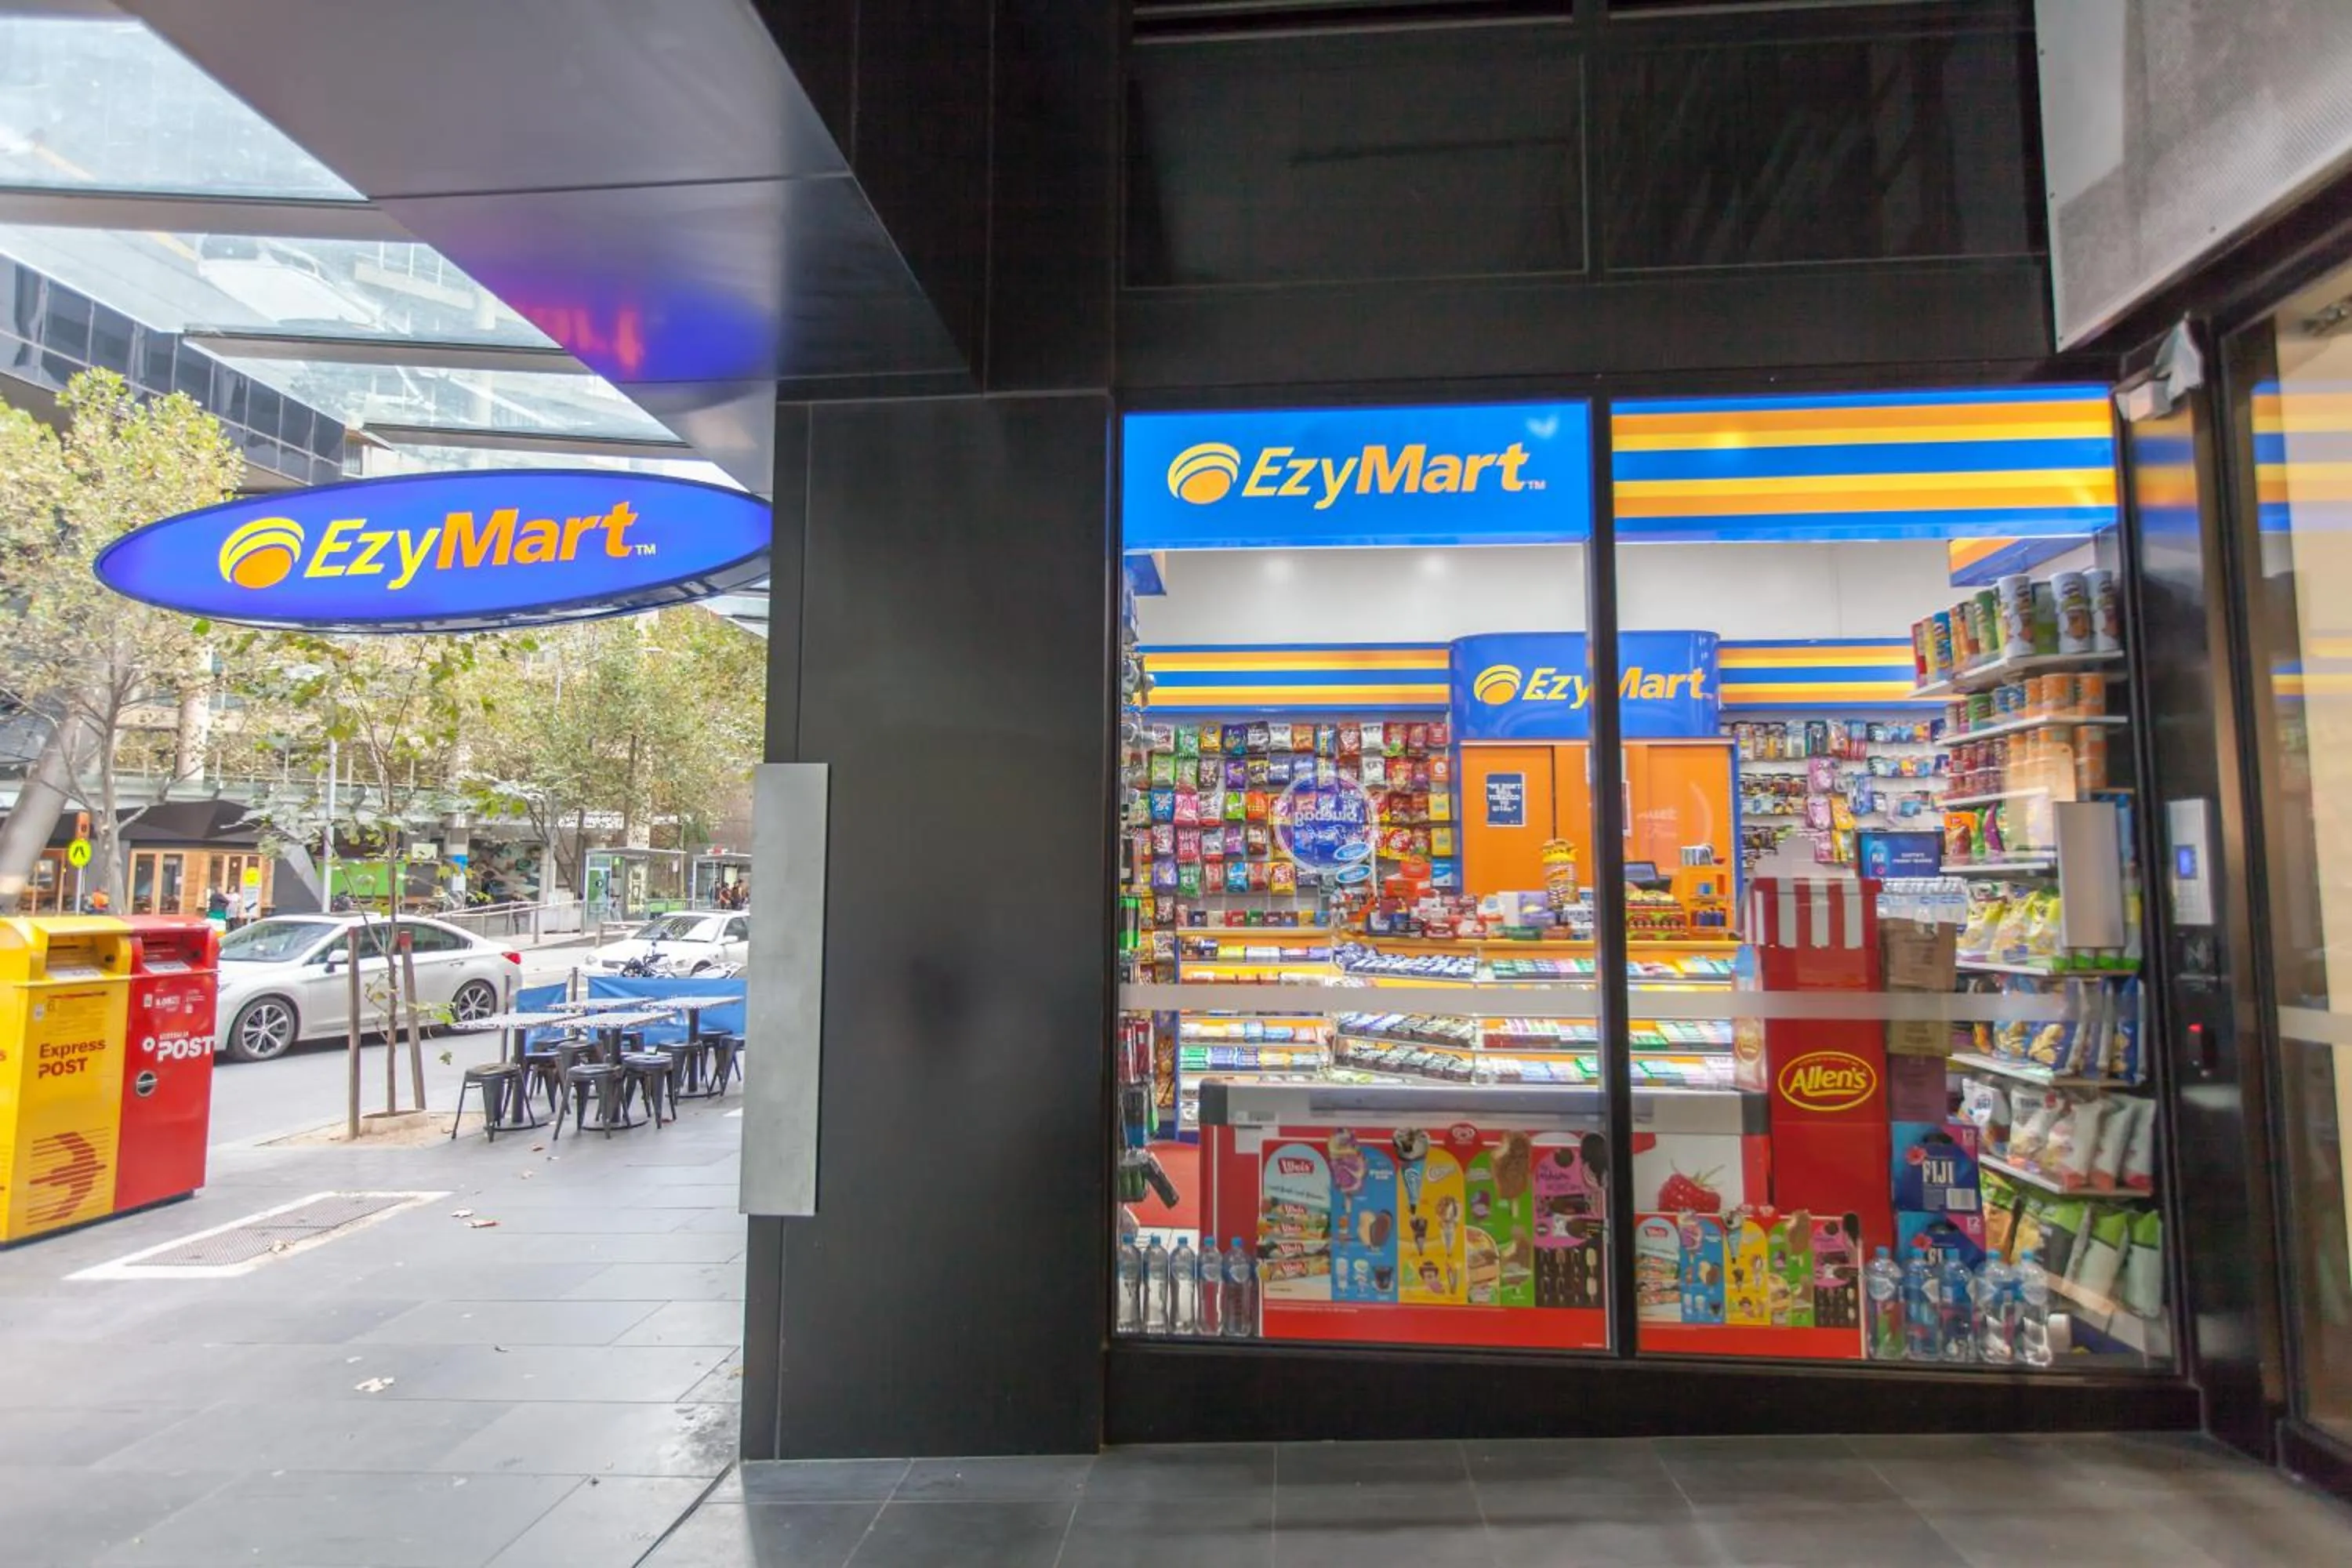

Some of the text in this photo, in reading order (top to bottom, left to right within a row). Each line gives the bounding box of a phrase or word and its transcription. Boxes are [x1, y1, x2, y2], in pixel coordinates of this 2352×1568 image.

[1241, 441, 1530, 509] EzyMart
[303, 502, 638, 590] EzyMart
[39, 1039, 107, 1059] Express
[157, 1036, 215, 1063] POST
[38, 1058, 89, 1079] POST
[1788, 1065, 1867, 1097] Allen's
[1922, 1160, 1955, 1185] FIJI
[1966, 1216, 1981, 1227] 12
